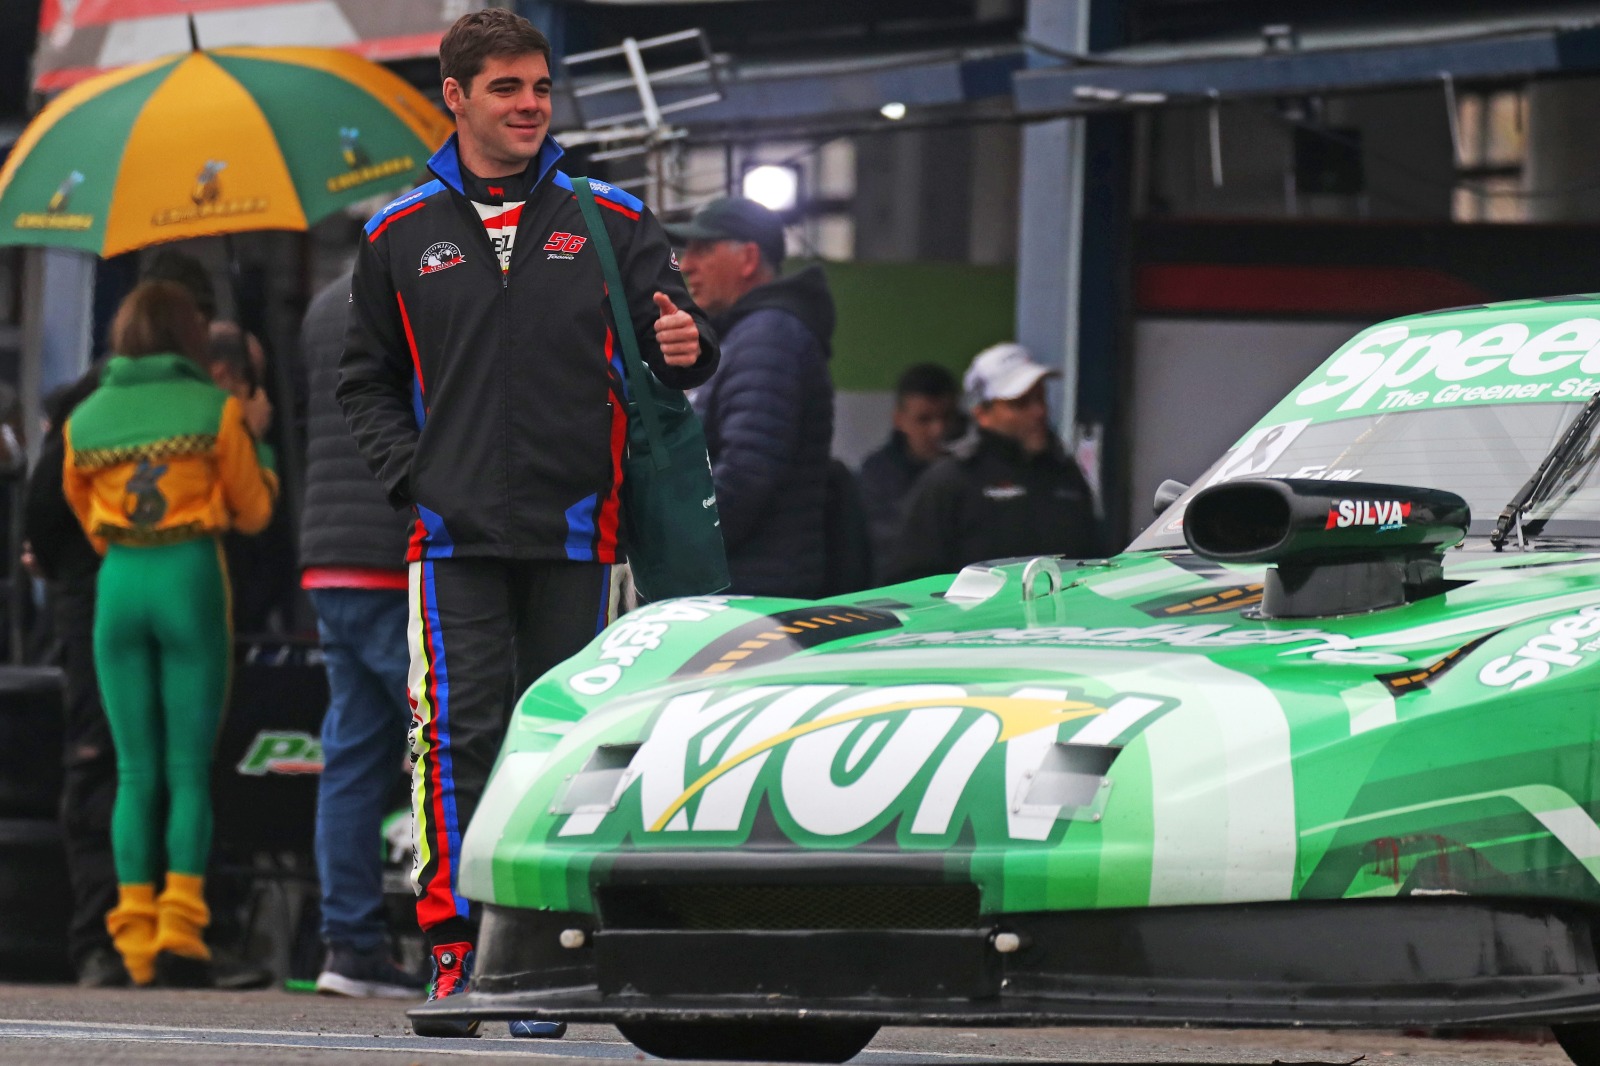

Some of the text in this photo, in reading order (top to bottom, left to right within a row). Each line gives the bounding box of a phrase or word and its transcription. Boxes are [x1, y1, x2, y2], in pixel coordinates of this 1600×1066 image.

[543, 231, 588, 254] 56
[1377, 389, 1430, 410] The
[1432, 382, 1553, 404] Greener
[1337, 500, 1403, 528] SILVA
[555, 684, 1166, 842] XION
